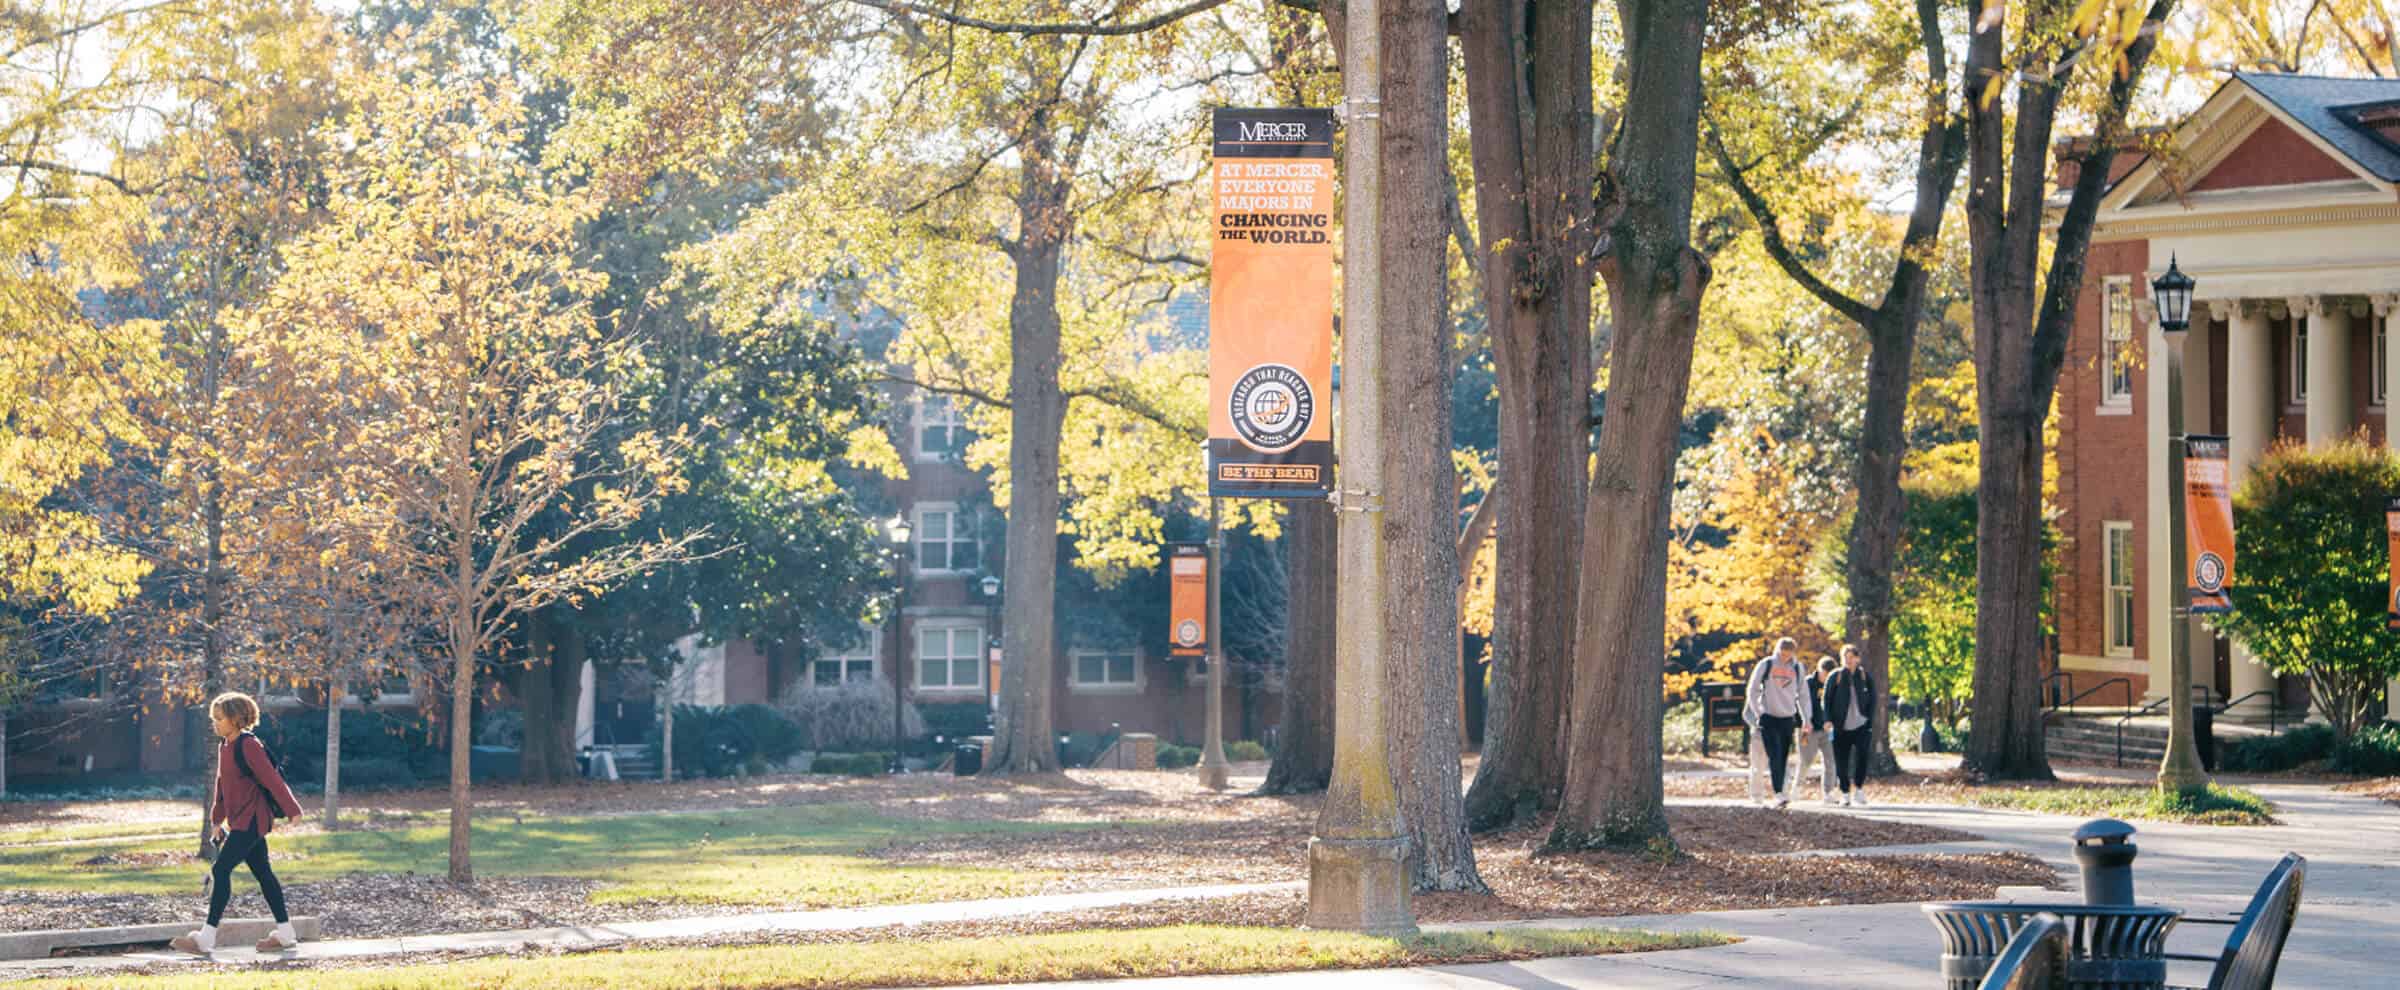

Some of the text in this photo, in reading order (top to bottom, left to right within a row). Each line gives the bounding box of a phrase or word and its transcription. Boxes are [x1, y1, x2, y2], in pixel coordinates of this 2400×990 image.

[1240, 122, 1308, 140] MERCER
[1220, 164, 1328, 179] AT MERCER,
[1220, 180, 1315, 193] EVERYONE
[1220, 196, 1312, 212] MAJORS IN
[1220, 214, 1327, 227] CHANGING
[1220, 230, 1331, 244] THE WORLD.
[1256, 369, 1277, 381] THAT
[1223, 467, 1314, 479] BE THE BEAR
